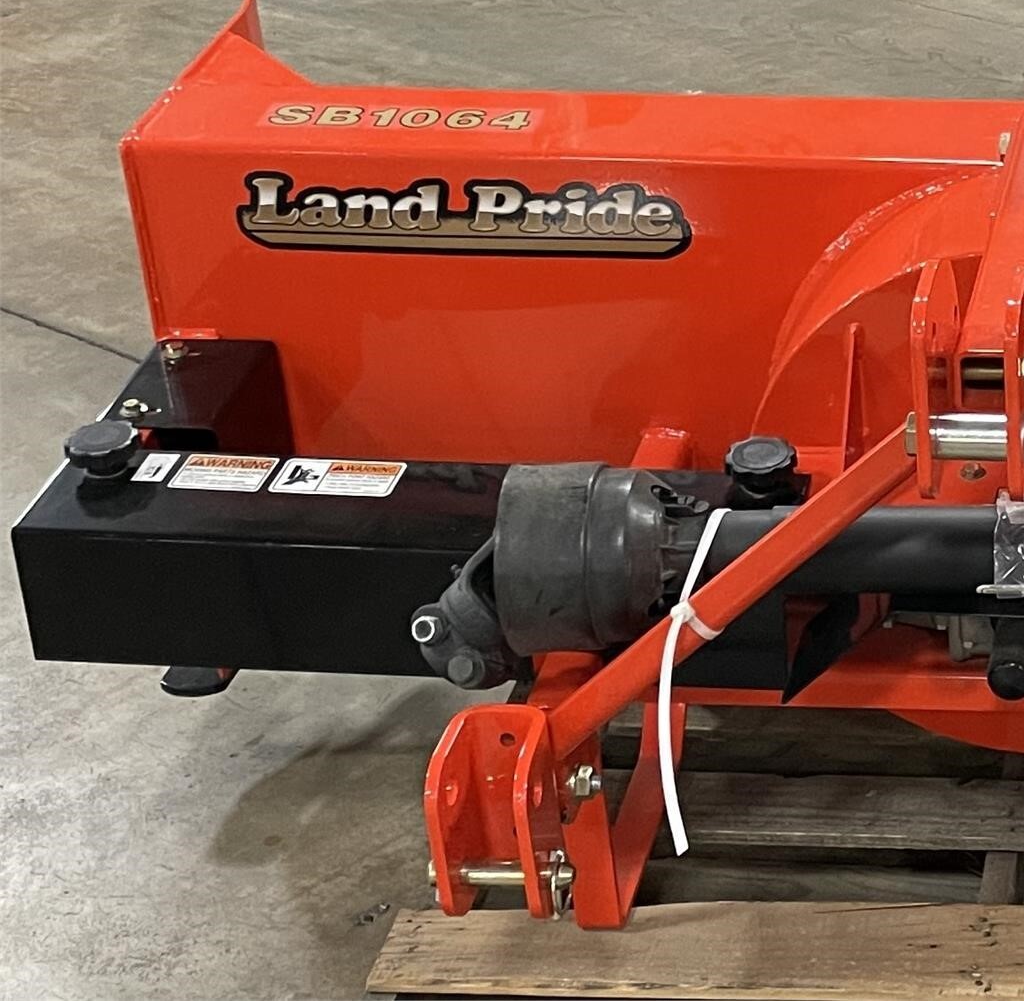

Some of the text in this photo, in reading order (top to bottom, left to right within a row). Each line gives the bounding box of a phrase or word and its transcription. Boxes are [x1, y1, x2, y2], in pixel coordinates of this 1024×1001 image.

[268, 105, 532, 130] SB1064
[250, 177, 675, 236] Land Pride
[206, 458, 272, 469] WARNING
